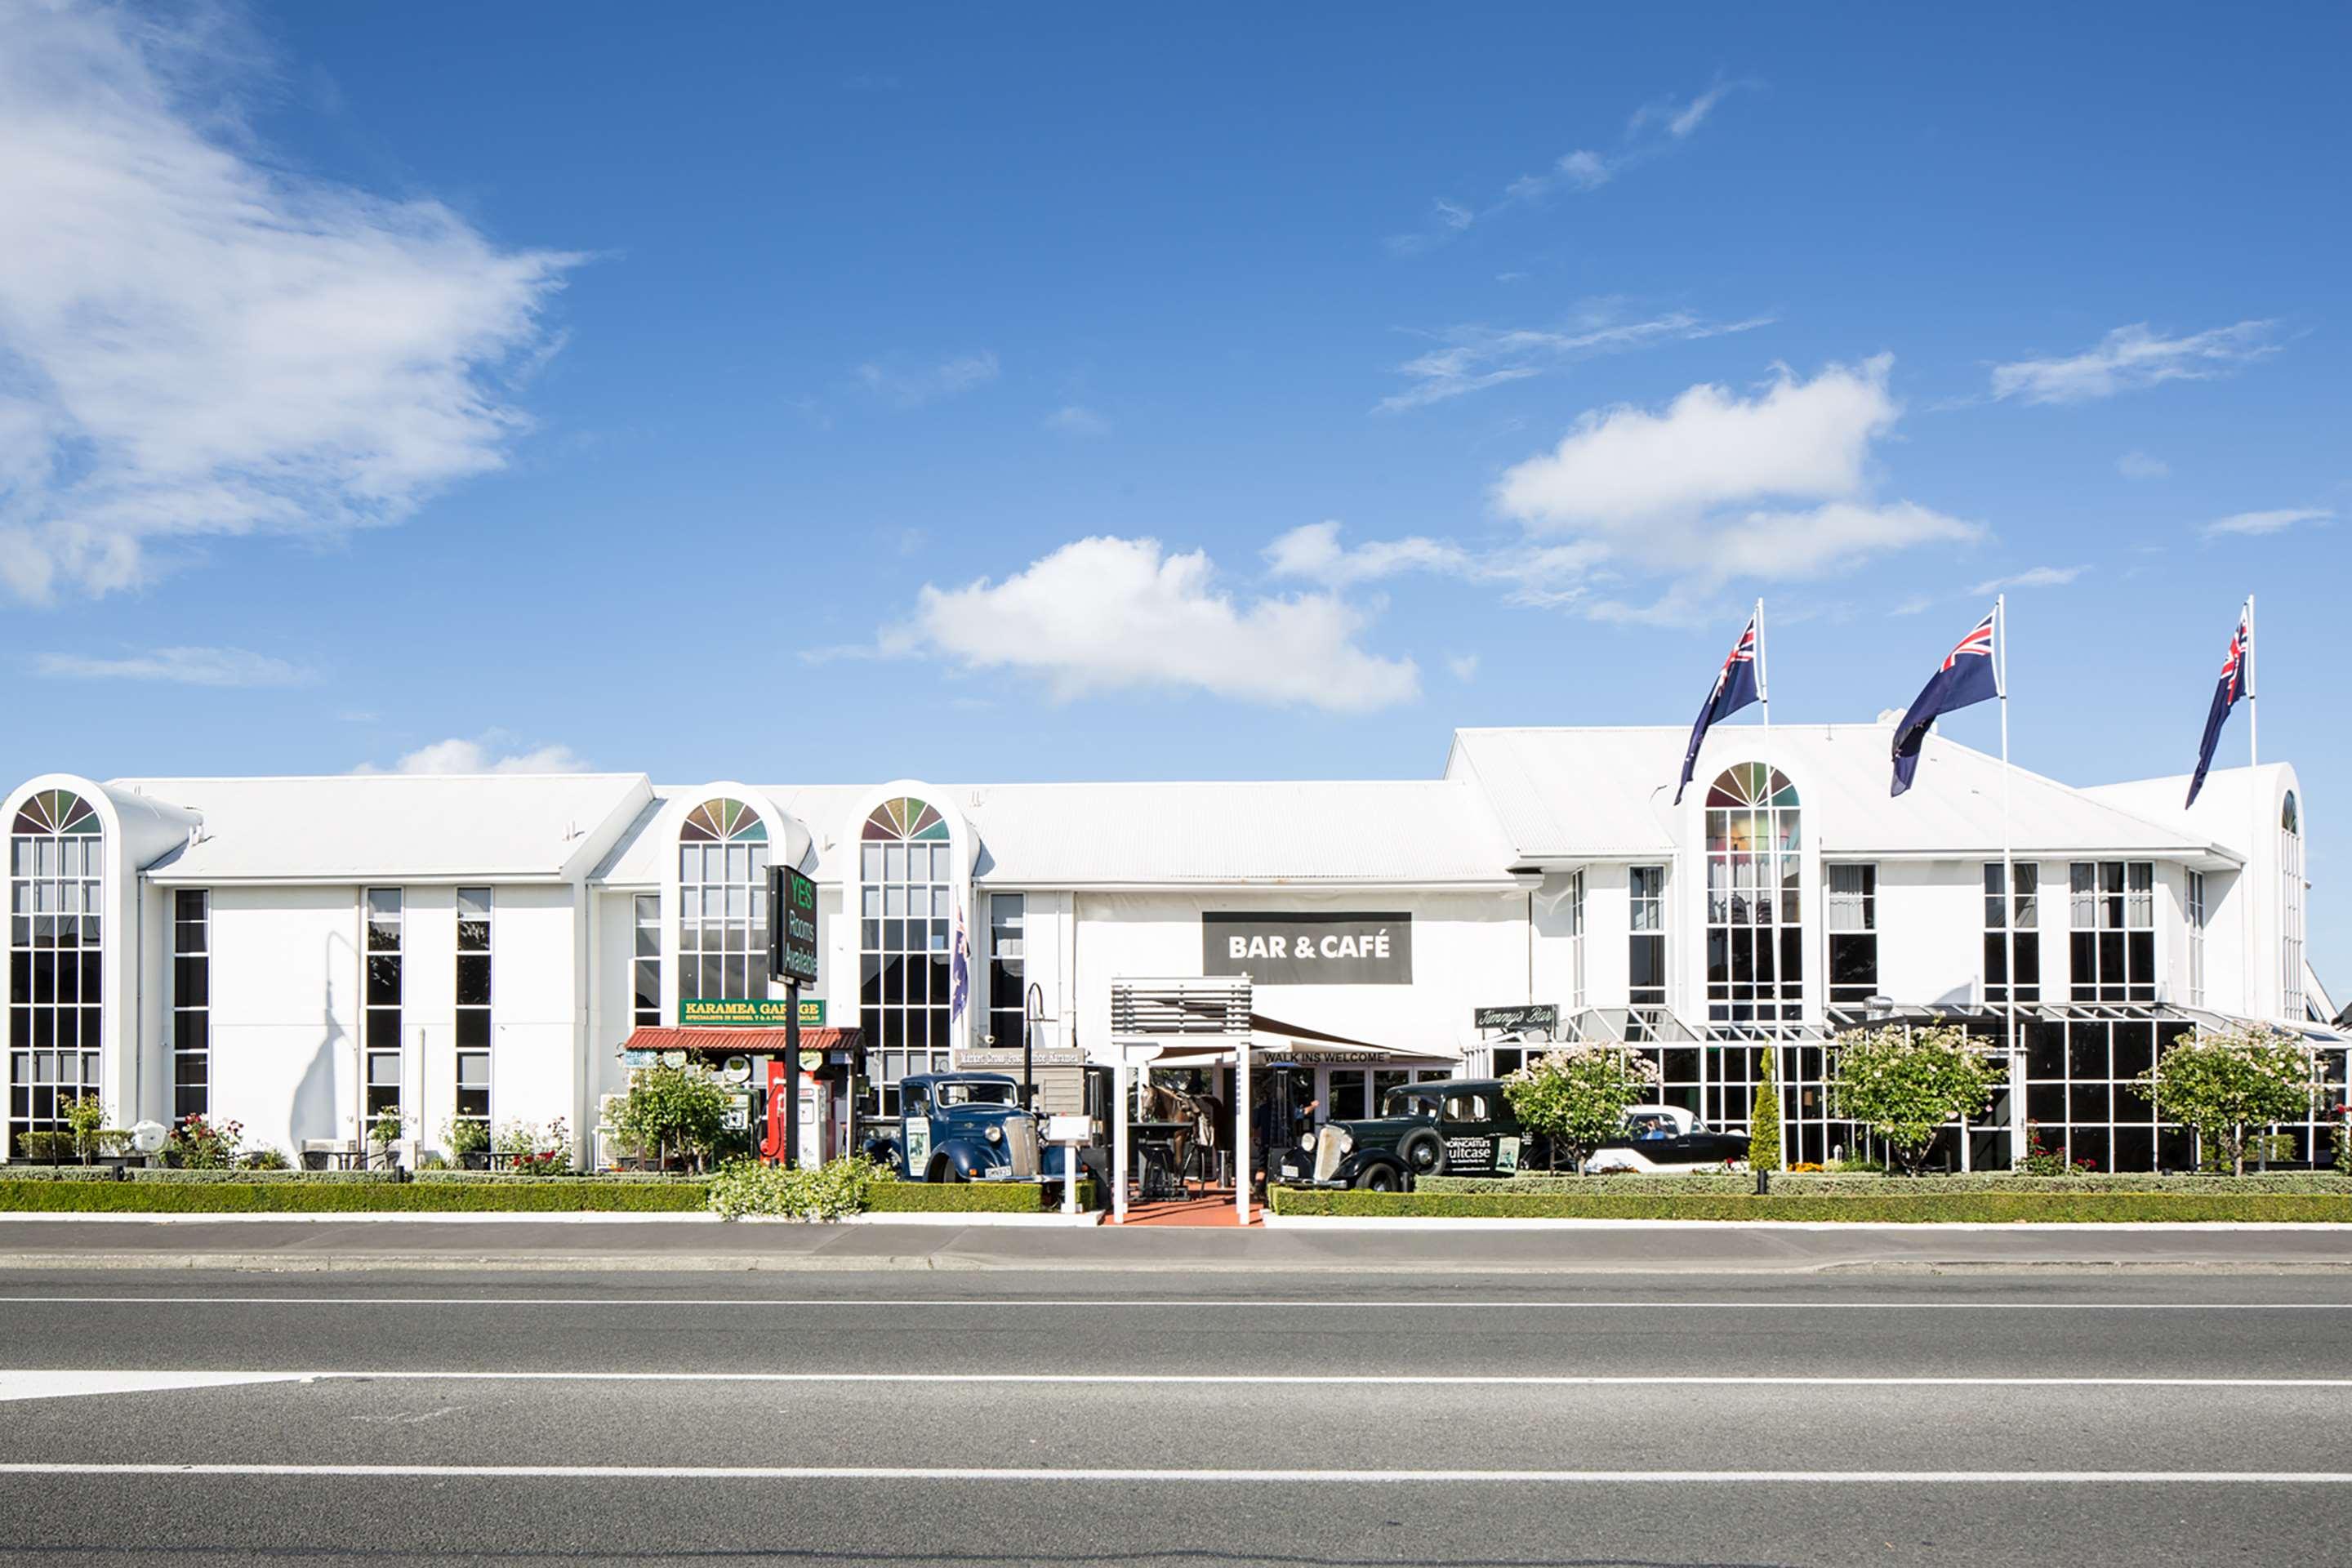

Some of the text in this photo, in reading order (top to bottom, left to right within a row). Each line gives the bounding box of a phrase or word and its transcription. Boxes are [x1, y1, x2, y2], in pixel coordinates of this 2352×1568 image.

[791, 874, 813, 910] YES
[1229, 929, 1390, 959] BAR & CAFÉ
[685, 1003, 819, 1014] KARAMEA GARGE
[1526, 1006, 1554, 1023] Bar
[1265, 1052, 1385, 1062] WALK INS WELCOME
